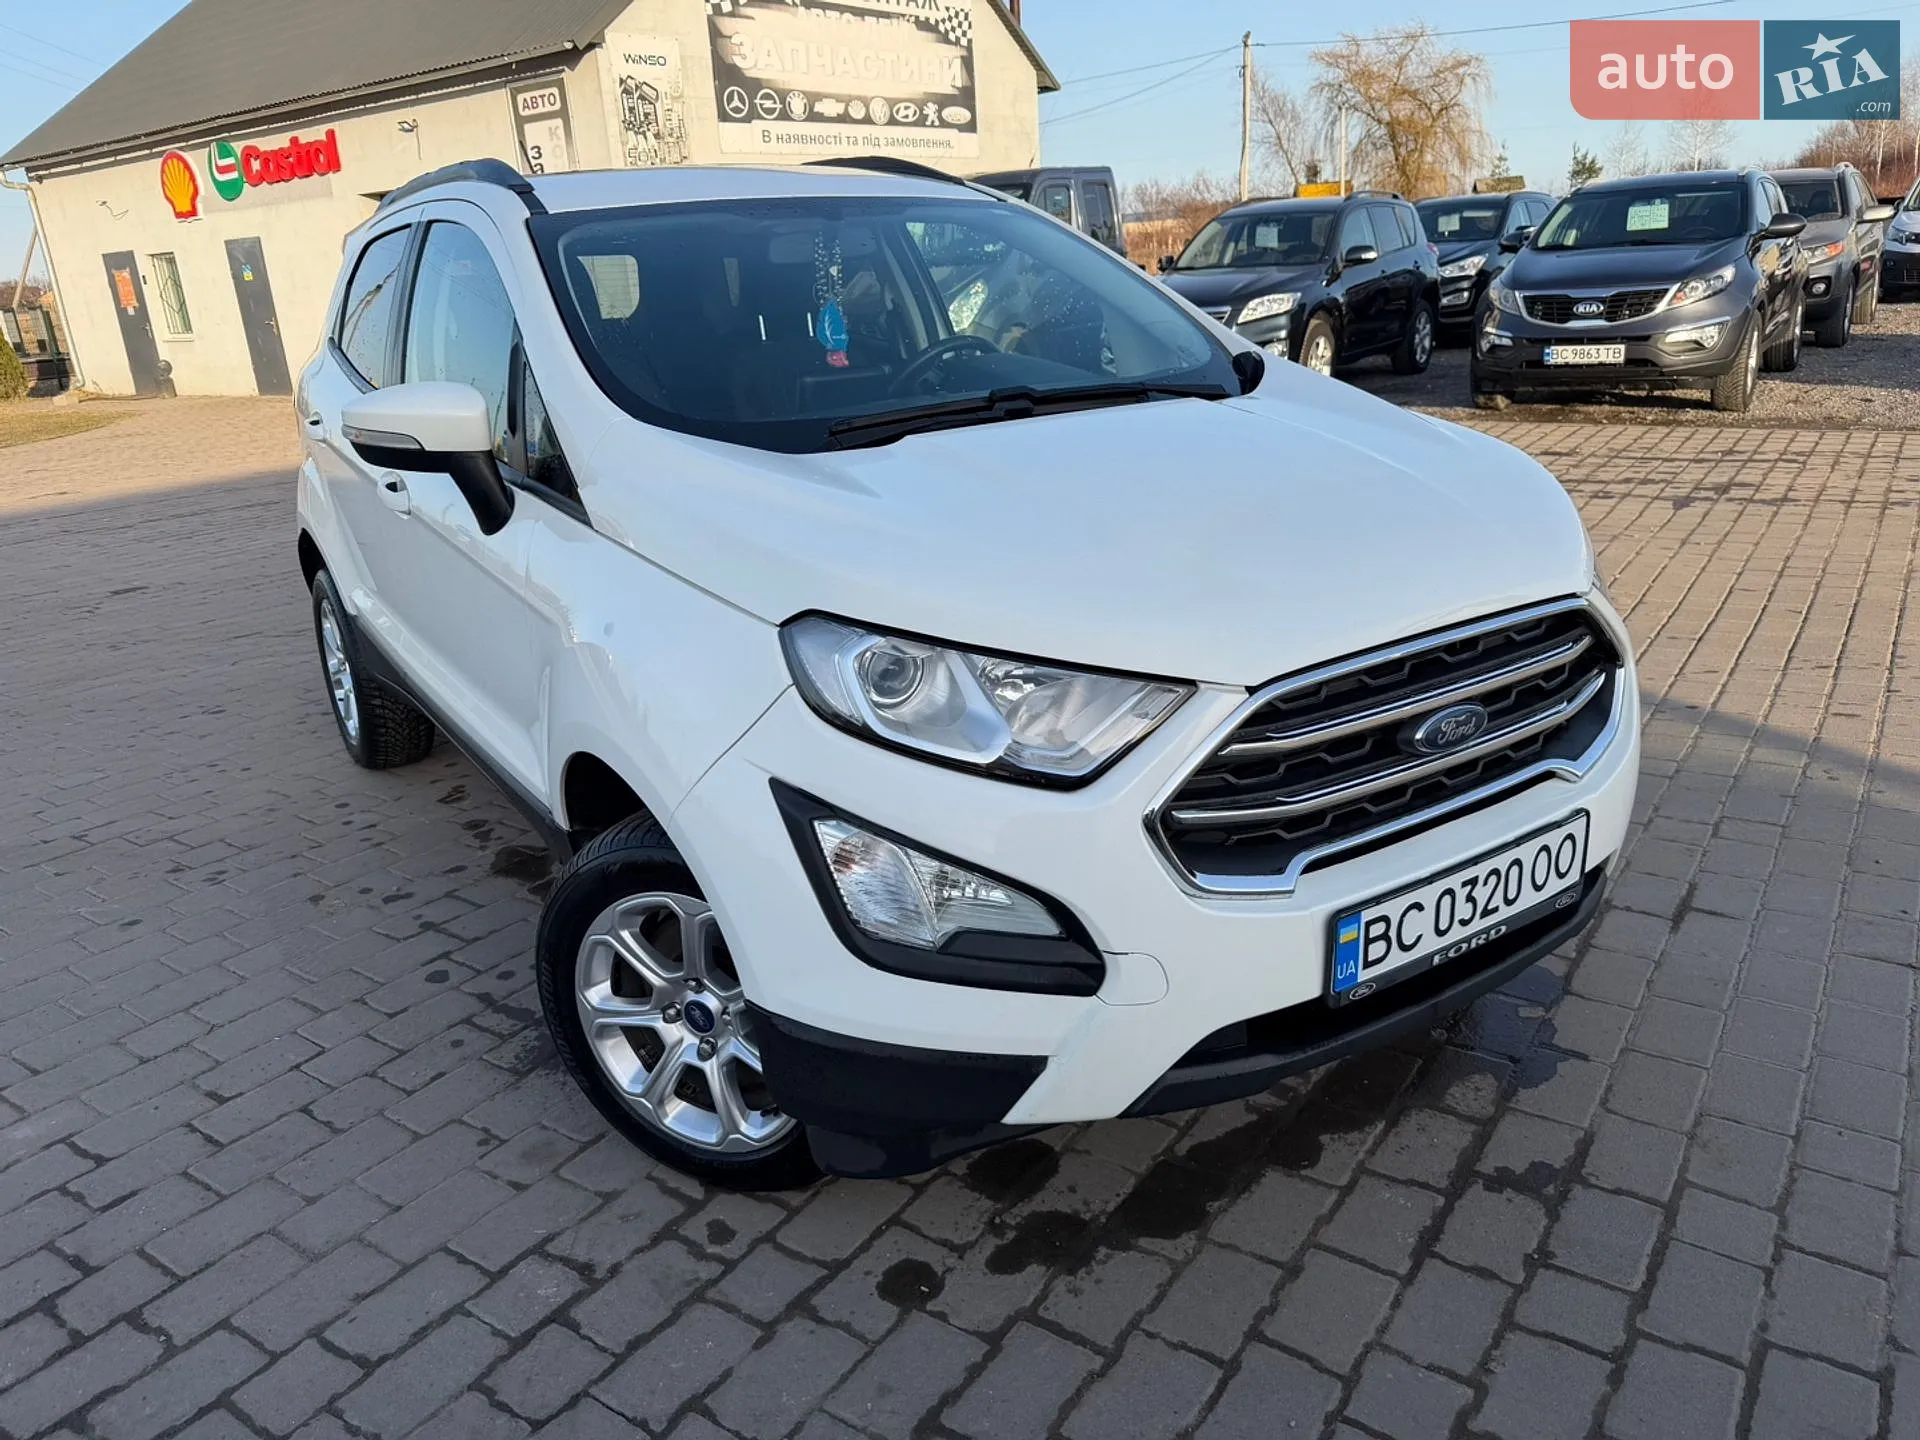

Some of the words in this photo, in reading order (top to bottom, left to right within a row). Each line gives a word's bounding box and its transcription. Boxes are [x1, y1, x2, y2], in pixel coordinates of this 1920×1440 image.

[729, 32, 963, 89] ЗАПЧАСТИНИ
[521, 92, 557, 113] АВТО
[761, 129, 772, 143] В
[776, 132, 842, 145] наявності
[845, 133, 859, 146] та
[862, 132, 881, 148] під
[883, 138, 955, 149] замовлення.
[240, 128, 342, 187] Castrol
[1577, 304, 1598, 312] KIA
[1571, 348, 1601, 360] 9863
[1603, 347, 1622, 359] TB
[1437, 712, 1476, 744] Ford
[1362, 901, 1426, 970] BC
[1434, 857, 1524, 938] 0320
[1431, 925, 1508, 967] FORD
[1336, 959, 1357, 980] UA
